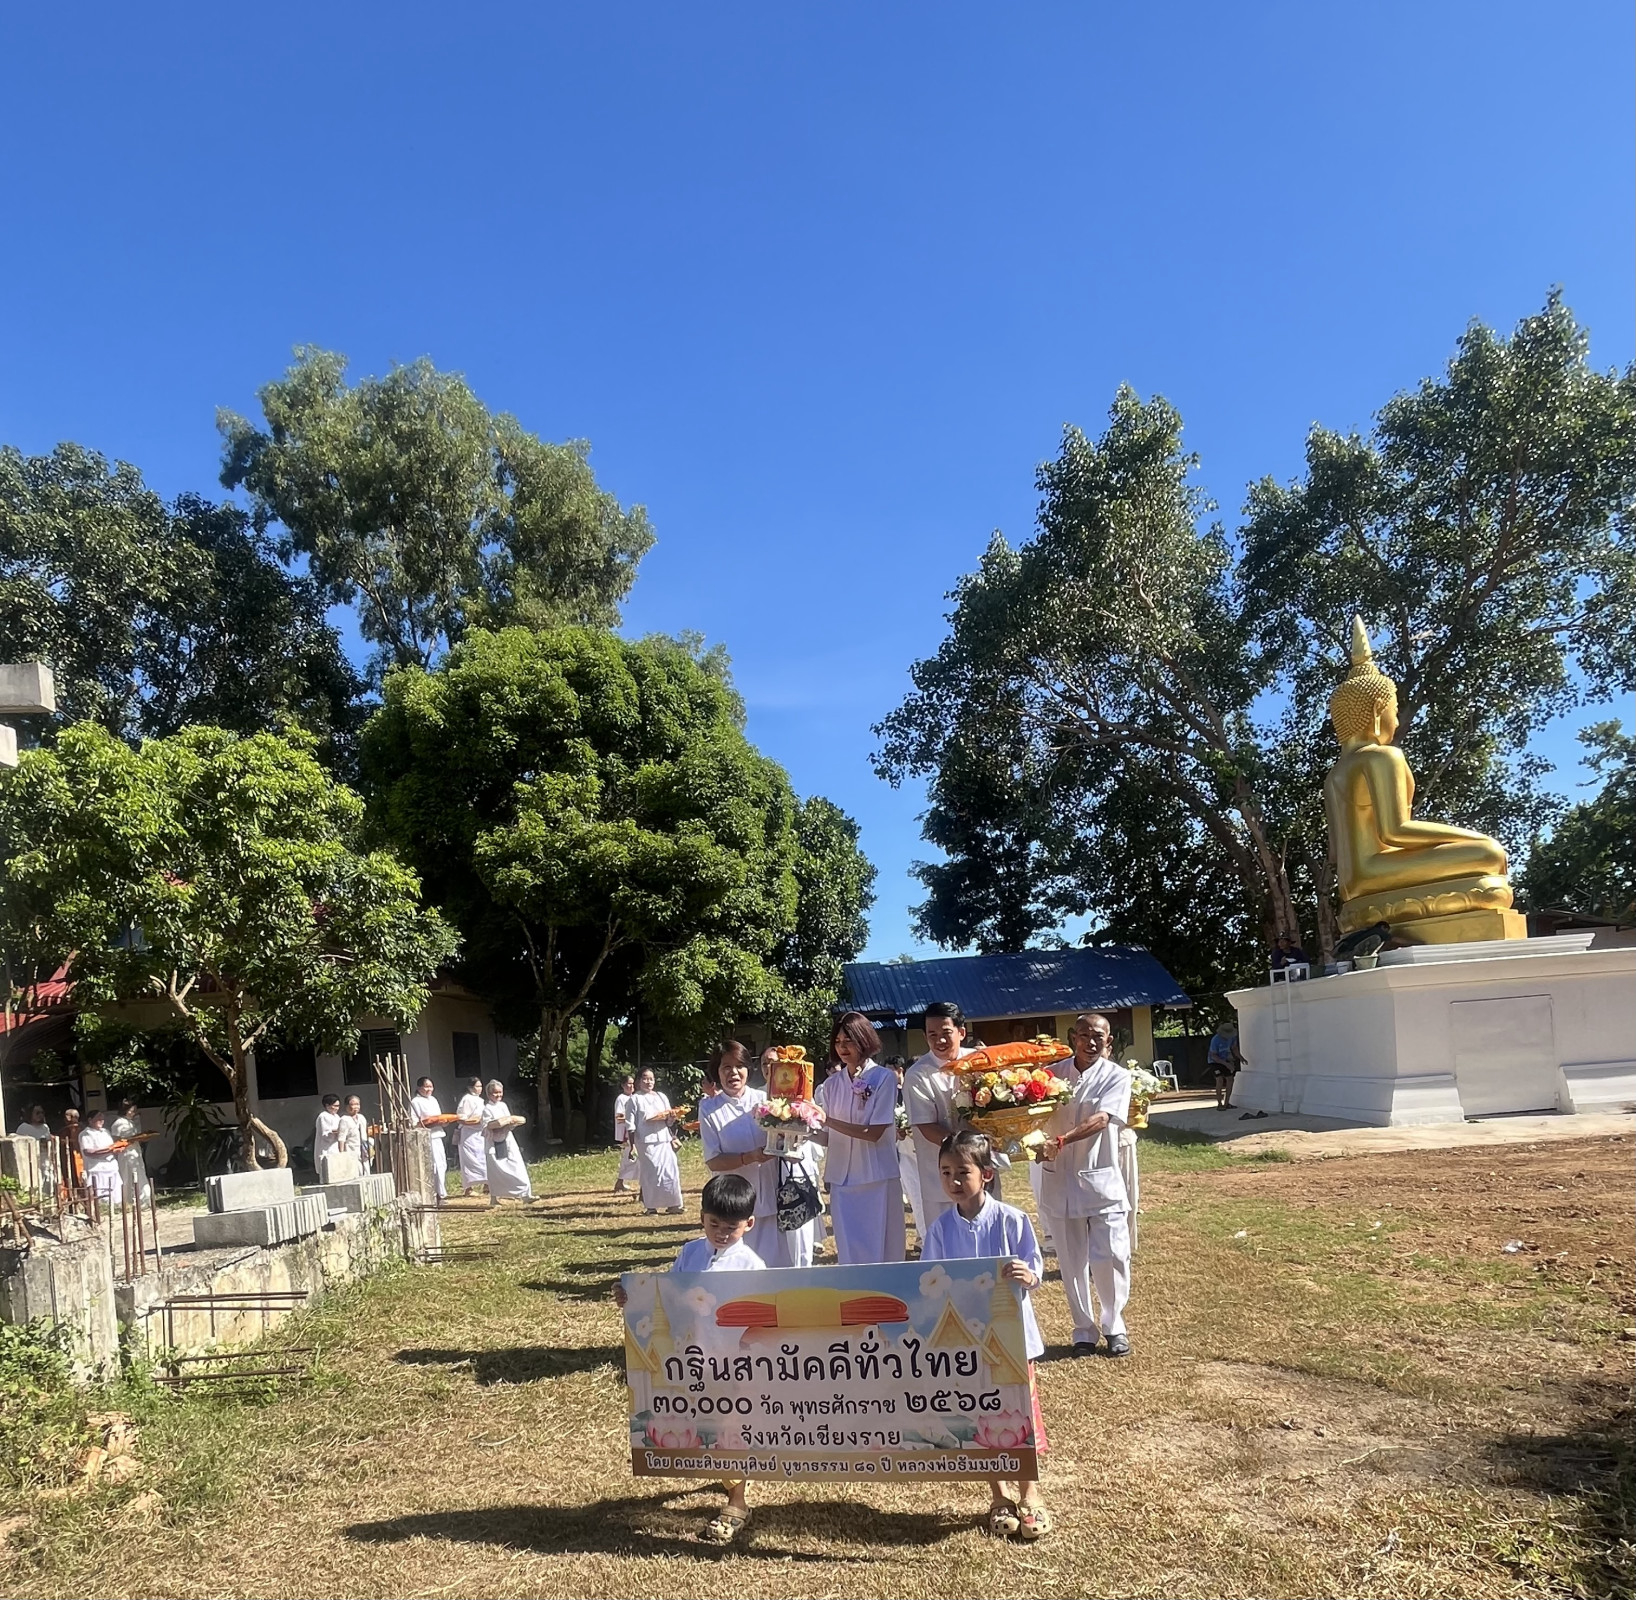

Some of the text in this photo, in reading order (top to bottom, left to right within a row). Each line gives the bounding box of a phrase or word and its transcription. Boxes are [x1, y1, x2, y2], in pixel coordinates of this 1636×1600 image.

[664, 1331, 979, 1392] กฐินสามัคคีทั่วไทย
[653, 1389, 1002, 1422] ๓๐,๐๐๐ วัด พุทธศักราช ๒๕๖๘
[741, 1424, 901, 1447] จังหวัดเชียงราย
[646, 1453, 1020, 1476] โดย คณะศิษยานุศิษย์ บูชาธรรม ๘๑ ปี หลวงพ่อธัมมชโย
